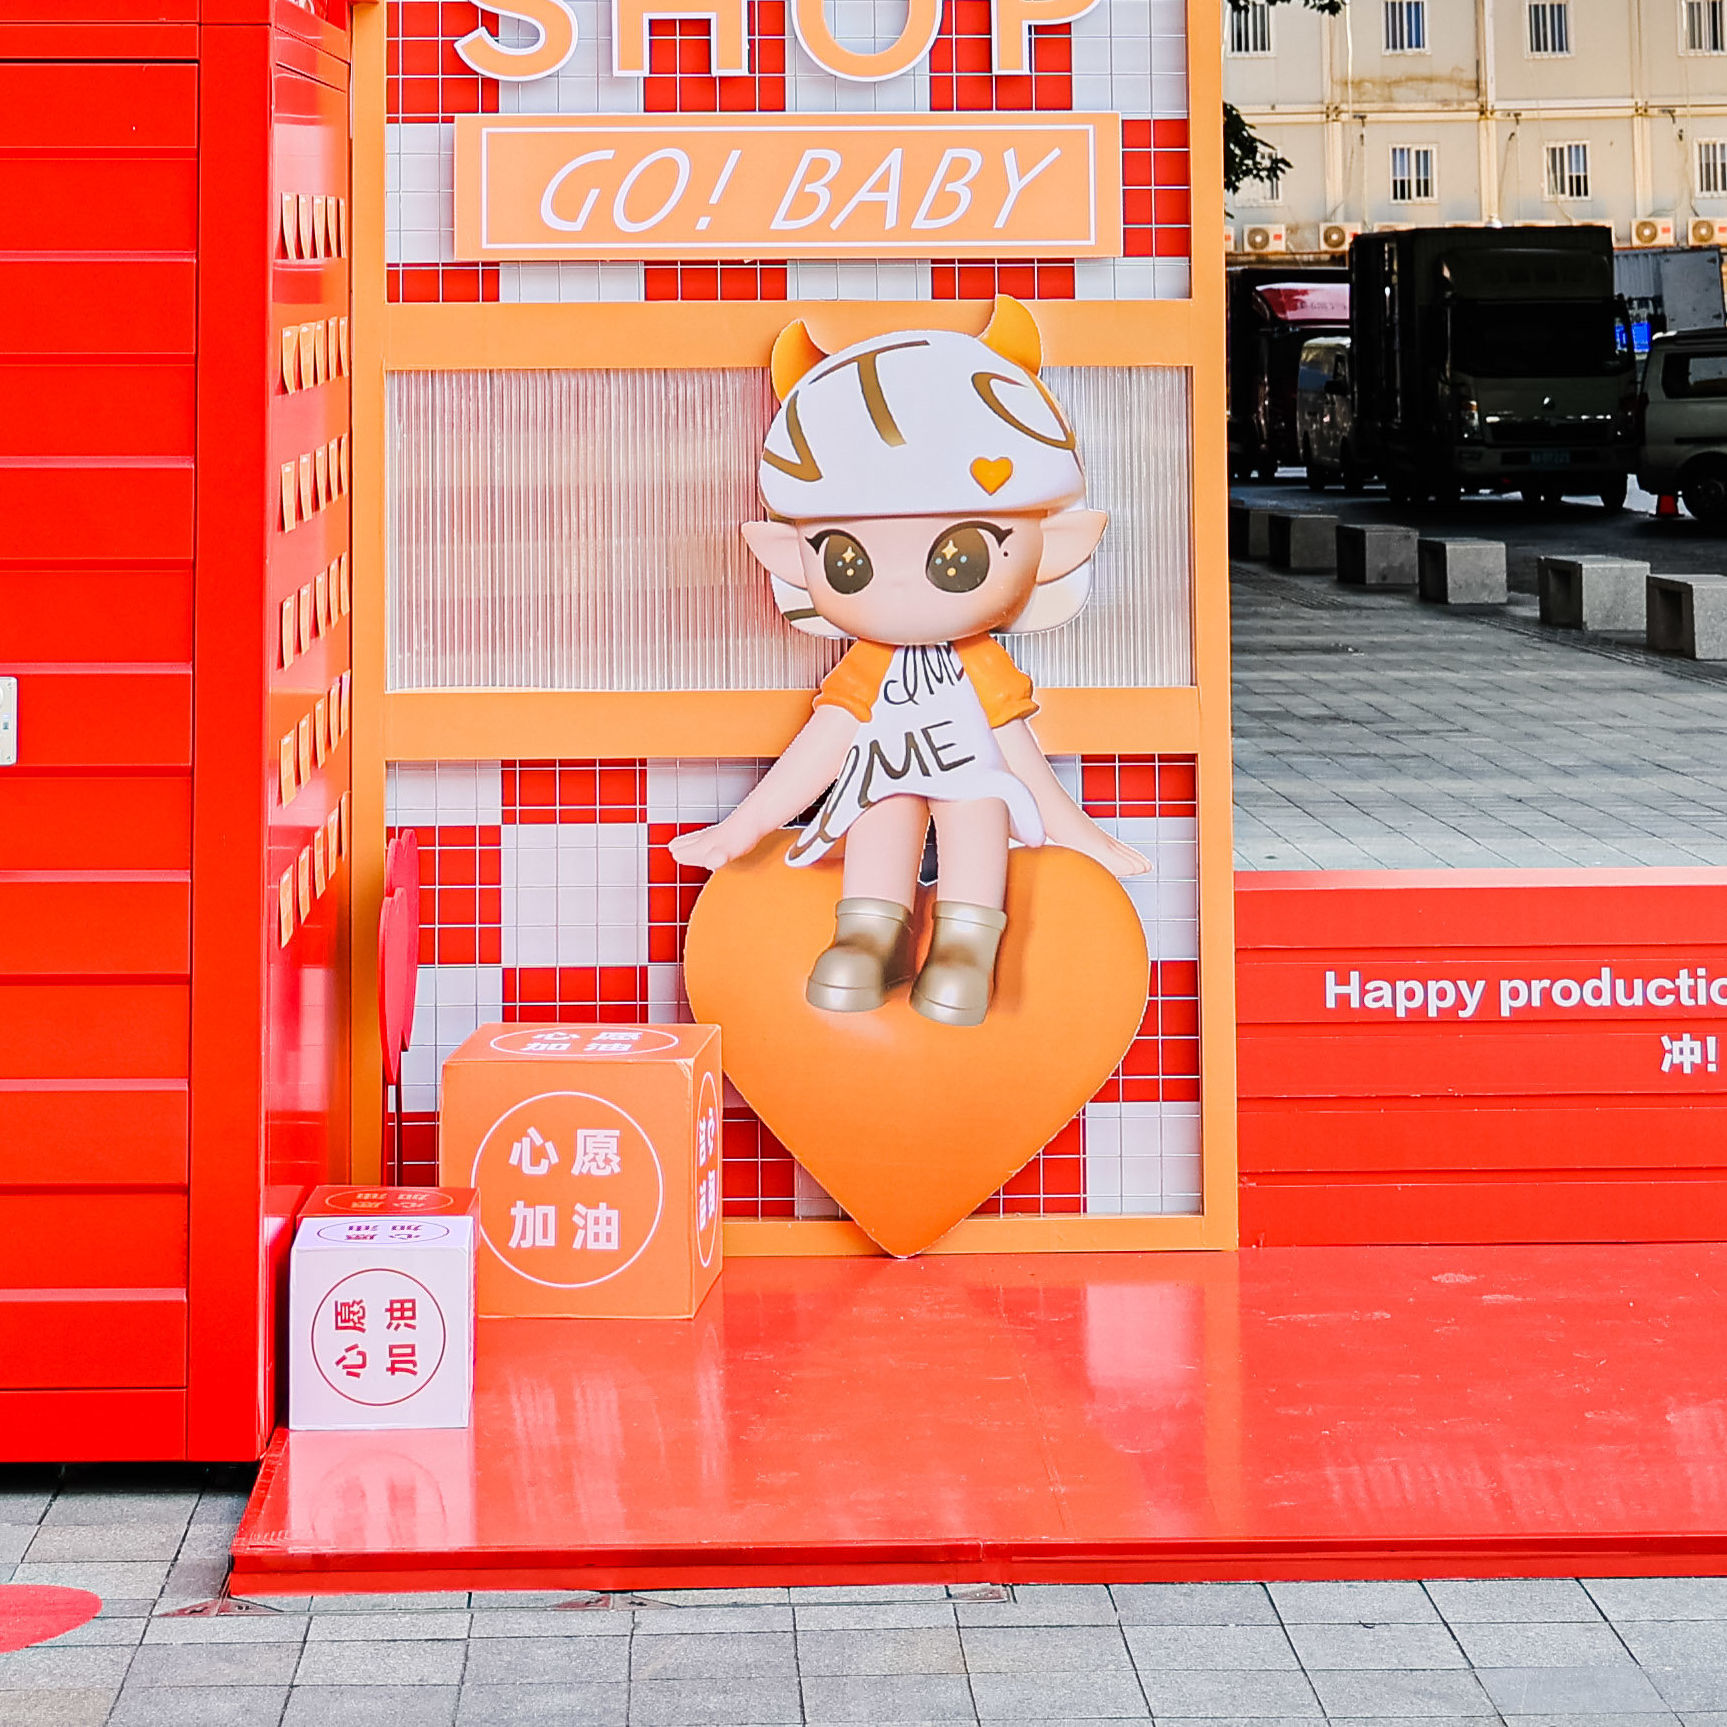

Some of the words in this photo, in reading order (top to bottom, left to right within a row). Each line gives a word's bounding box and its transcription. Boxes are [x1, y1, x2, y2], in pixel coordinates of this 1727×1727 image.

[540, 148, 742, 233] GO!
[770, 146, 1062, 232] BABY
[1326, 970, 1484, 1020] Happy
[508, 1126, 621, 1177] 心愿
[508, 1199, 621, 1251] 加油
[333, 1298, 367, 1379] 心愿
[384, 1297, 419, 1377] 加油
